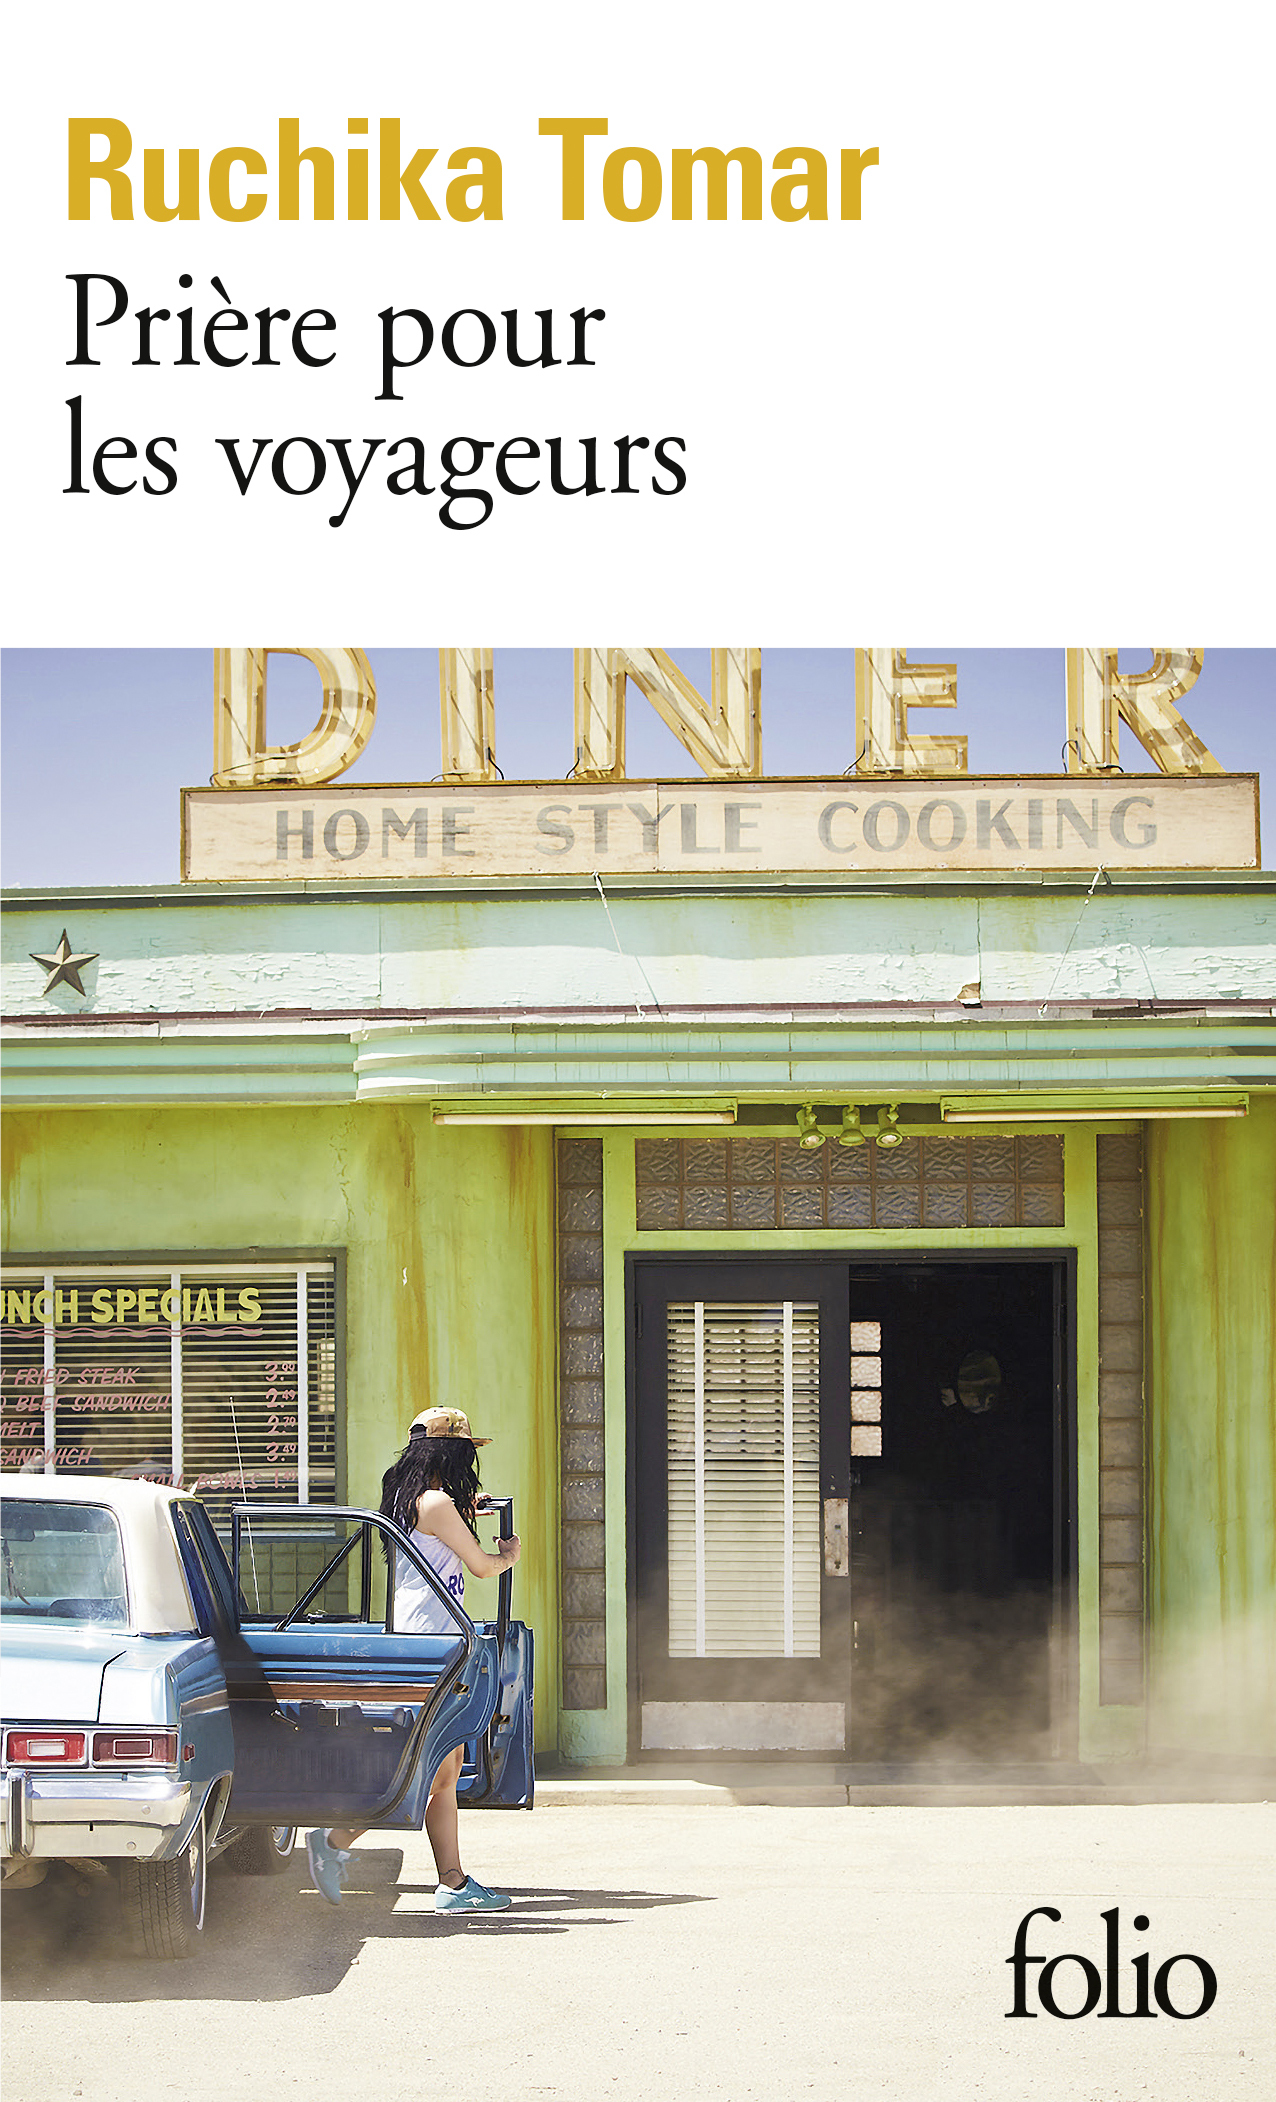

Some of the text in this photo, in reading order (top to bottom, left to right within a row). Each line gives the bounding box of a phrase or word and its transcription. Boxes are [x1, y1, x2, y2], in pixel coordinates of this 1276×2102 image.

[213, 648, 1226, 787] DINER
[276, 796, 1158, 861] HOME STYLE COOKING
[1, 1287, 263, 1324] NCH SPECIALS
[14, 1368, 70, 1386] FRIED
[77, 1367, 140, 1385] STEAK
[264, 1361, 296, 1382] 3.99
[15, 1395, 66, 1412] BEEF
[71, 1393, 172, 1412] SANDWICH
[265, 1387, 297, 1408] 2.49
[265, 1441, 297, 1462] 3.49
[197, 1472, 262, 1490] BOWLS
